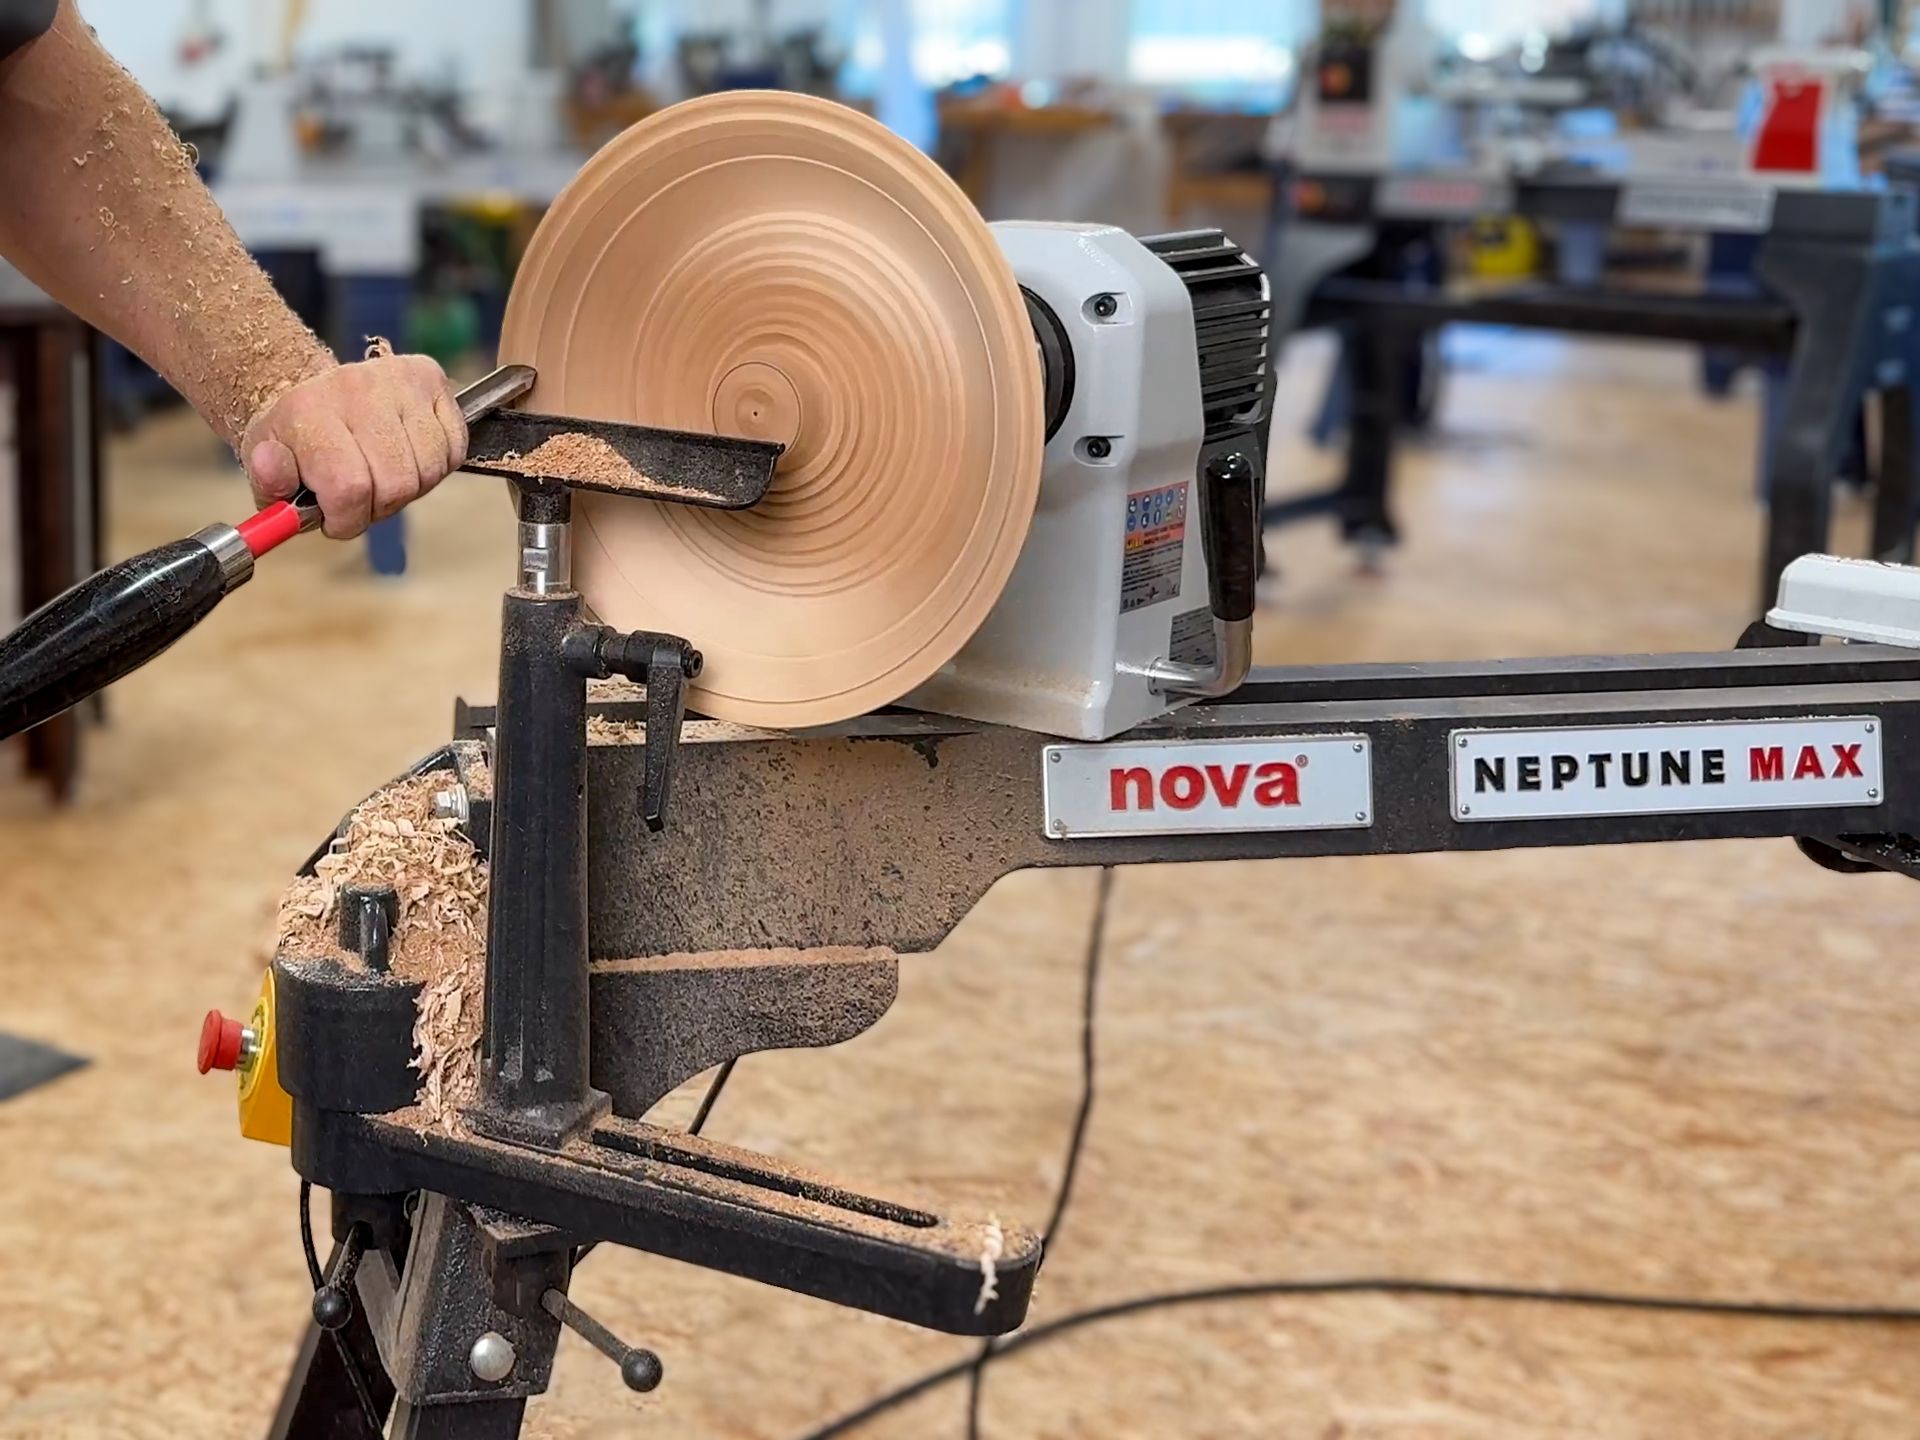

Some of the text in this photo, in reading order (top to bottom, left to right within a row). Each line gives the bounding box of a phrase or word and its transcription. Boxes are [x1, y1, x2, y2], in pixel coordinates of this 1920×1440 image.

[1110, 762, 1301, 811] nova
[1474, 743, 1864, 793] NEPTUNE MAX
